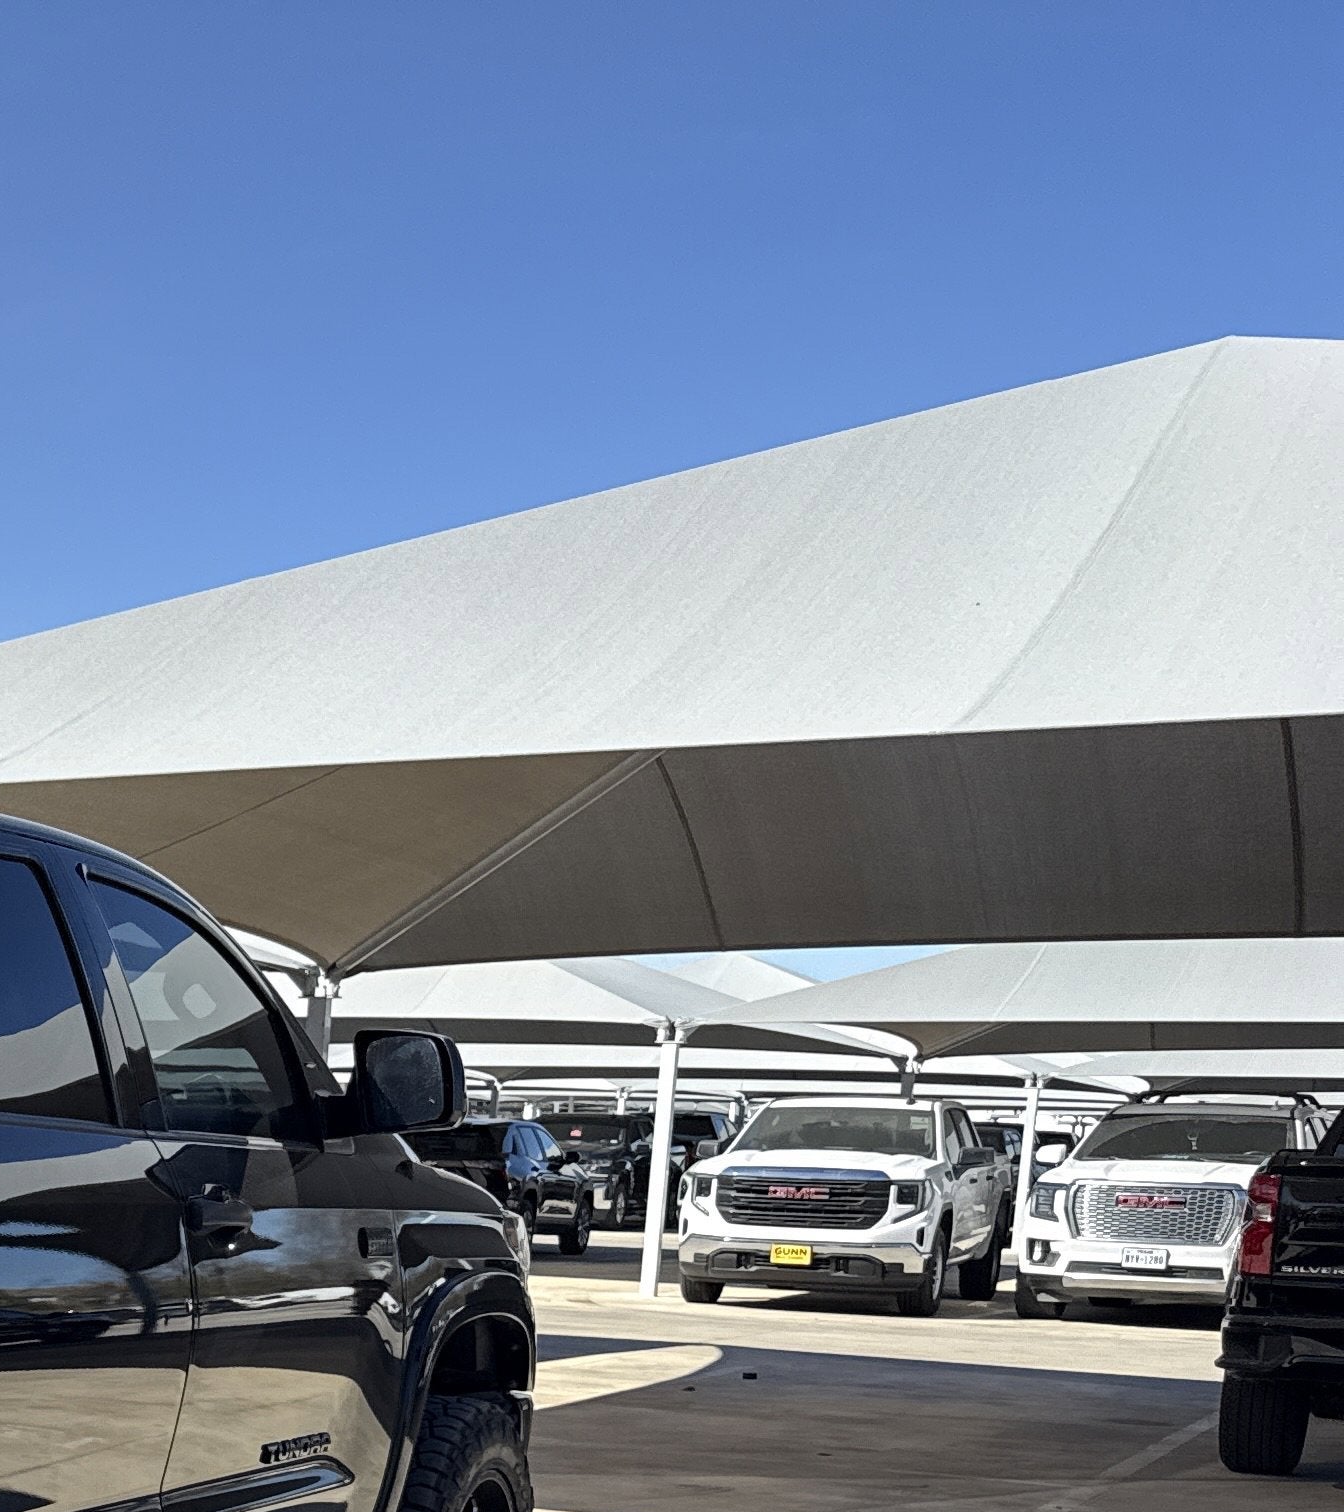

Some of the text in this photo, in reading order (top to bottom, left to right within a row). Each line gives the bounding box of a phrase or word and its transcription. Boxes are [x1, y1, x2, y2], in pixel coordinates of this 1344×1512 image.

[767, 1185, 830, 1200] GMC
[1115, 1194, 1187, 1209] GMC
[775, 1247, 808, 1256] GUNN
[259, 1432, 331, 1464] TUNDRA
